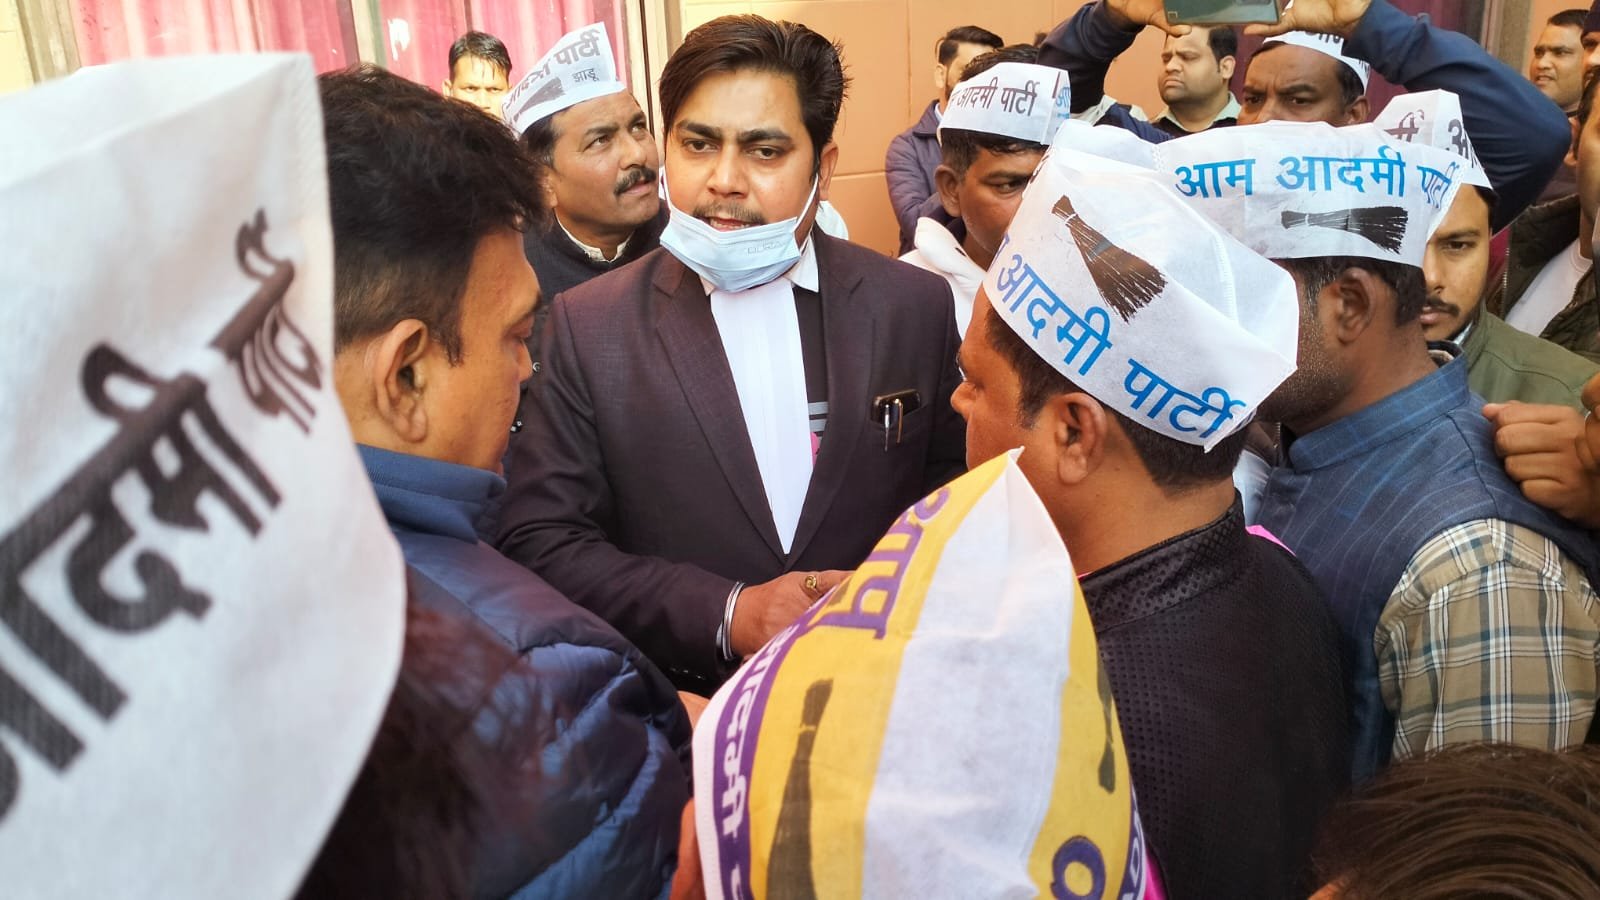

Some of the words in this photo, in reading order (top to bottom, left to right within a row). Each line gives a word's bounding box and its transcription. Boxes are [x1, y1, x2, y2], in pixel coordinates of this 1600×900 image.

[554, 28, 601, 65] पार्टी
[957, 76, 999, 110] आदमी
[1001, 80, 1041, 117] पार्टी
[1174, 158, 1256, 199] आम
[1276, 144, 1406, 197] आदमी
[1416, 161, 1460, 209] पार्टी
[208, 207, 325, 436] पार्टी
[997, 254, 1113, 376] आदमी
[1124, 357, 1246, 439] पार्टी
